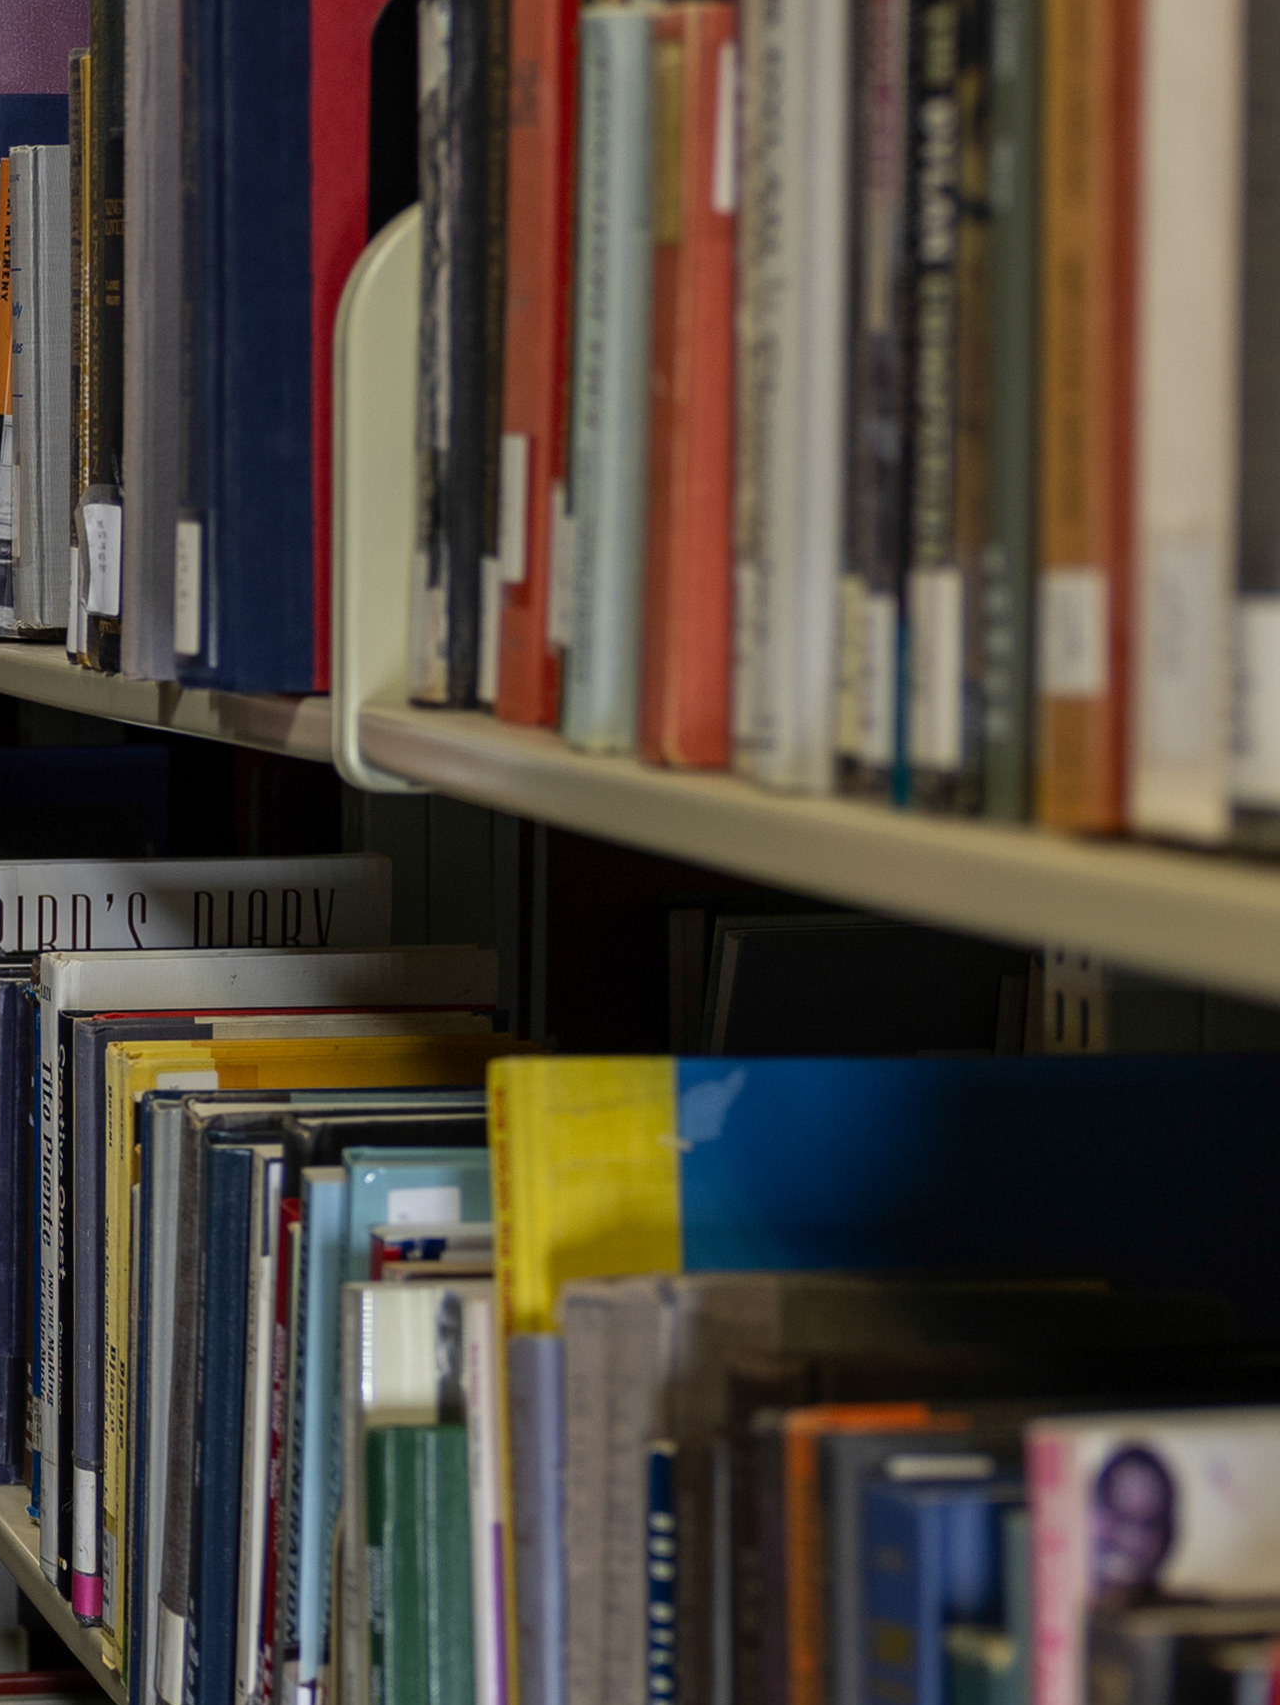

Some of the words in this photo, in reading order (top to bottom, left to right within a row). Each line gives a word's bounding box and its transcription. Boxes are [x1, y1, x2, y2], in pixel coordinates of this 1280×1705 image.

[0, 224, 13, 303] METHENY
[42, 1060, 56, 1109] Tito
[41, 1116, 56, 1245] Puente
[48, 1269, 57, 1298] AND
[48, 1303, 57, 1330] THE
[47, 1338, 57, 1407] Making
